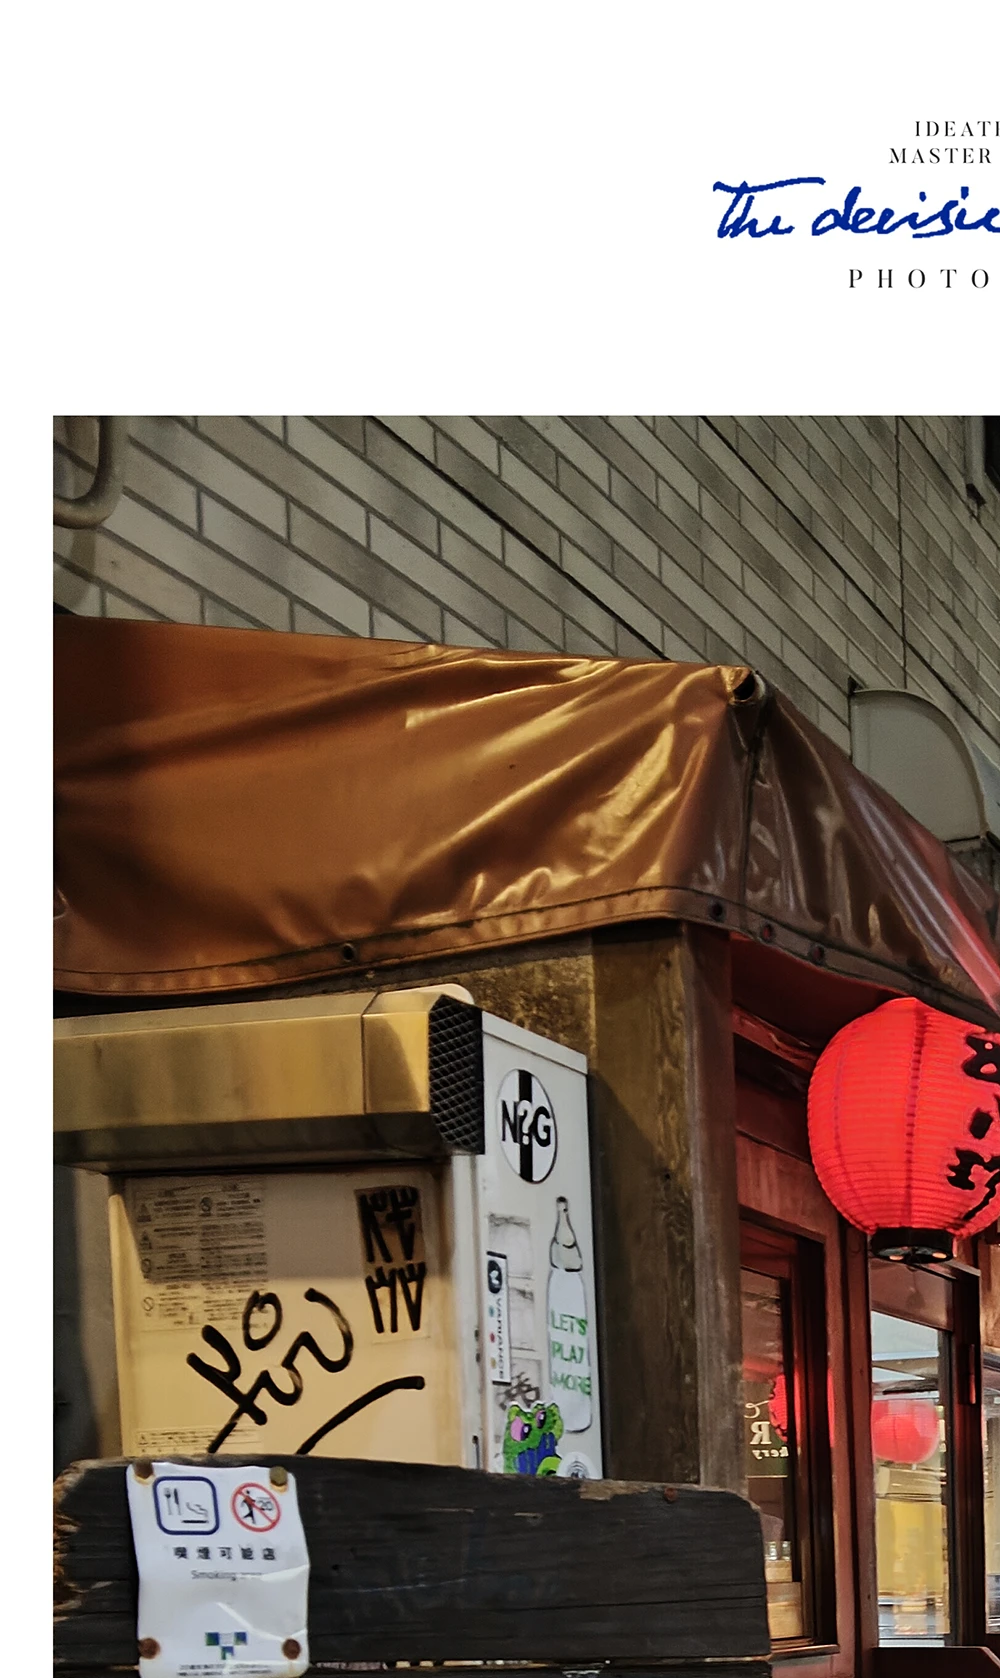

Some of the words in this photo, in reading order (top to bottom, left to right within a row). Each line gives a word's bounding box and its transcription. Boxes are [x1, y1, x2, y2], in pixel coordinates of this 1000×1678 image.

[173, 1546, 276, 1560] 喫煙可能店
[191, 1569, 237, 1581] Smoking
